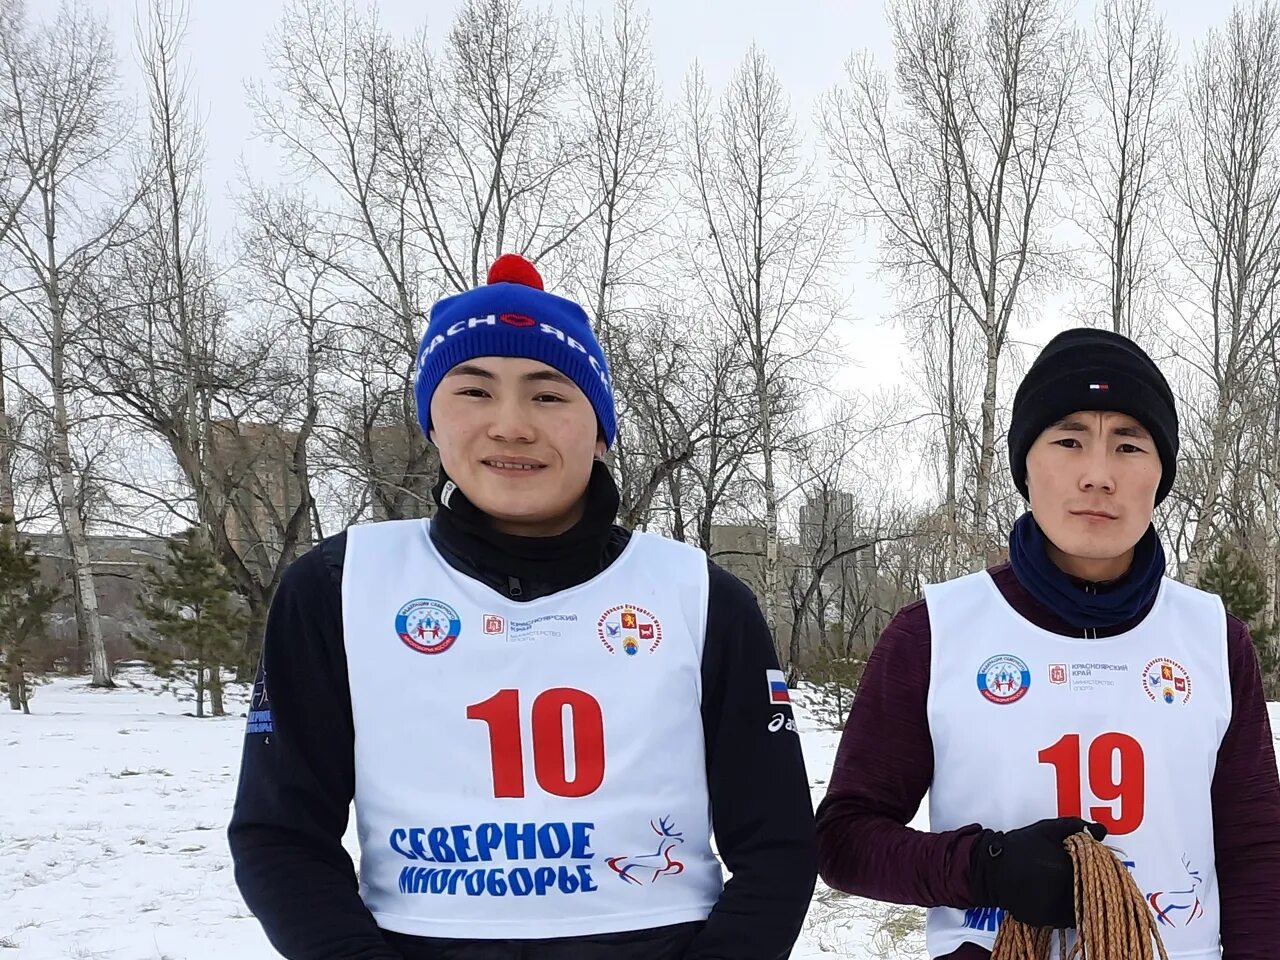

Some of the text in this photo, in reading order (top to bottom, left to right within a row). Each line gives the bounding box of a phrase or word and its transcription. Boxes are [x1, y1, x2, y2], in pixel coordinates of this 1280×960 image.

[466, 687, 606, 799] 10
[1038, 732, 1144, 835] 19
[389, 822, 596, 863] СЕВЕРНОЕ
[398, 865, 598, 896] МНОГОБОРЬЕ
